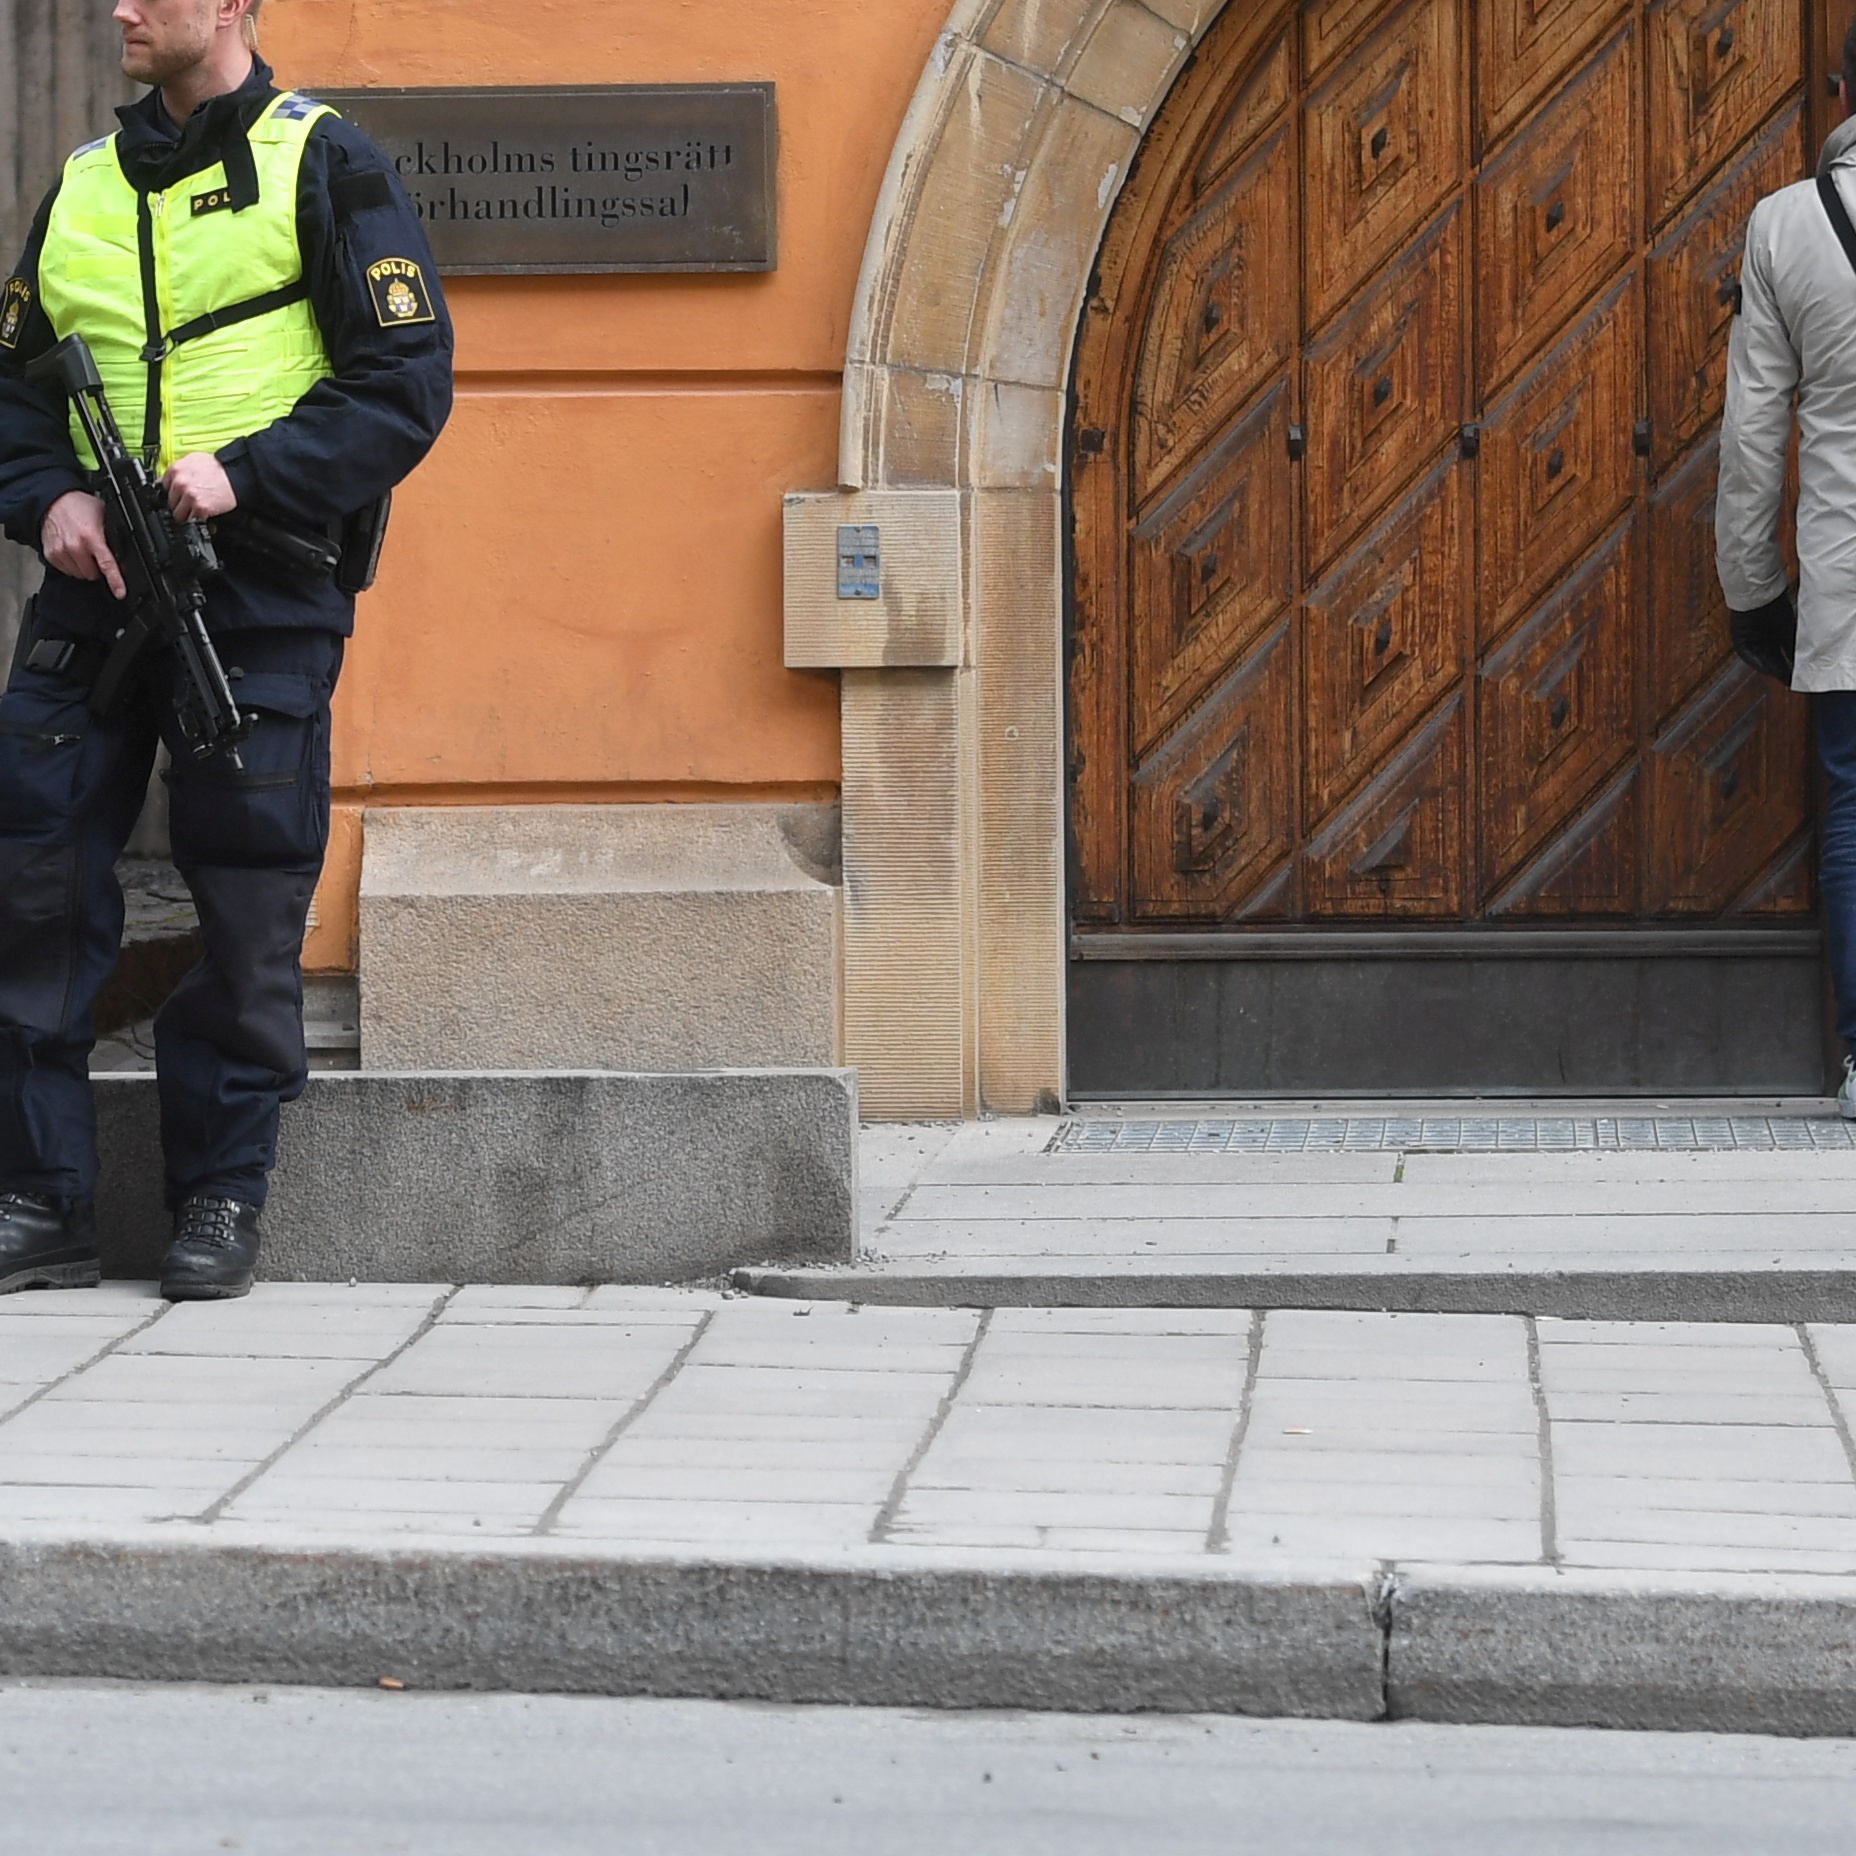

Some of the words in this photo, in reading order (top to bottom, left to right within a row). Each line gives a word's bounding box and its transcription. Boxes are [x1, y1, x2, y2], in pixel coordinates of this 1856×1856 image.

[394, 141, 556, 176] ckholms
[570, 140, 737, 183] tingsrätt
[193, 191, 231, 211] POL
[406, 182, 692, 229] örhandlingssal
[370, 261, 417, 282] POLIS
